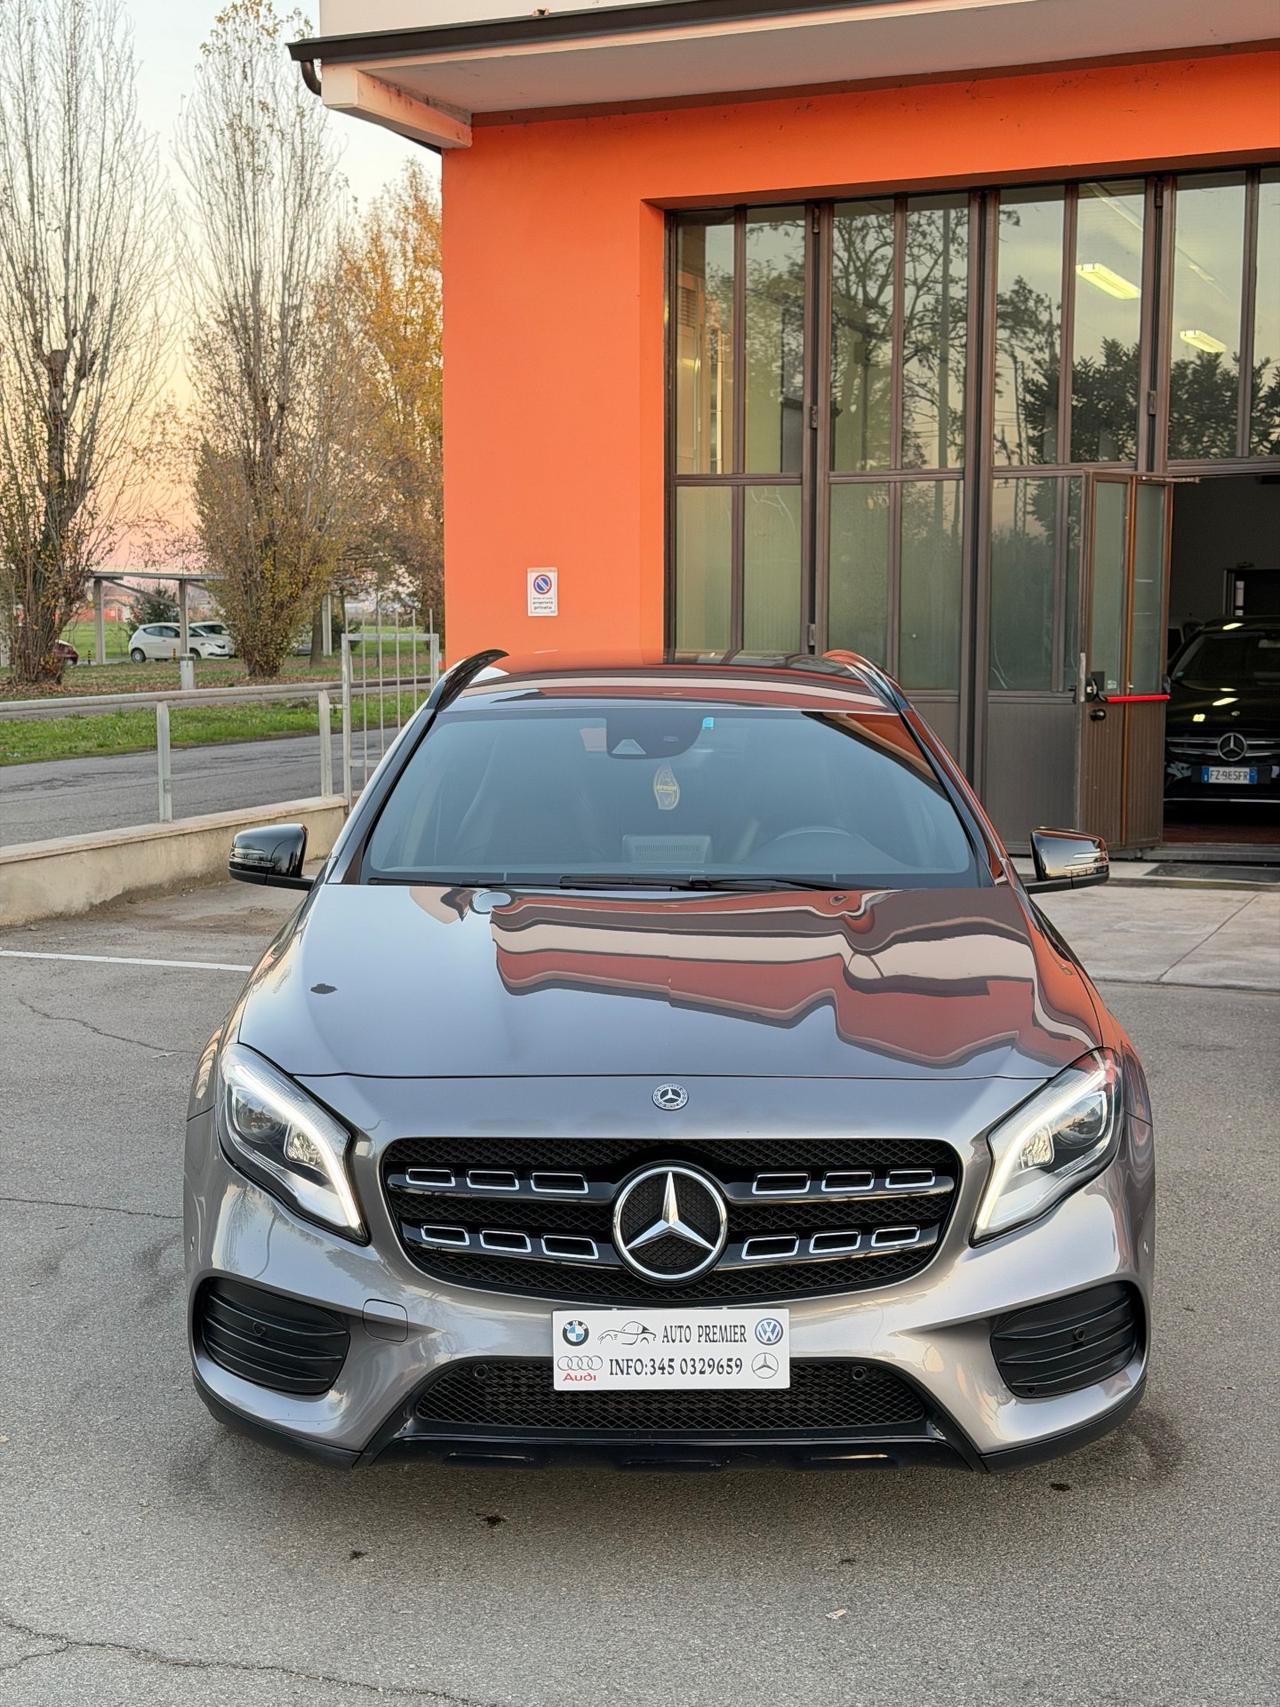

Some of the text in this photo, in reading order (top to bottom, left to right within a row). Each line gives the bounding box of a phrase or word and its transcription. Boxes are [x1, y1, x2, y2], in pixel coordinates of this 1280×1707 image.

[661, 1324, 747, 1343] AUTO PREMIER
[609, 1357, 743, 1376] INFO:345 0329659
[562, 1372, 597, 1382] Audi
